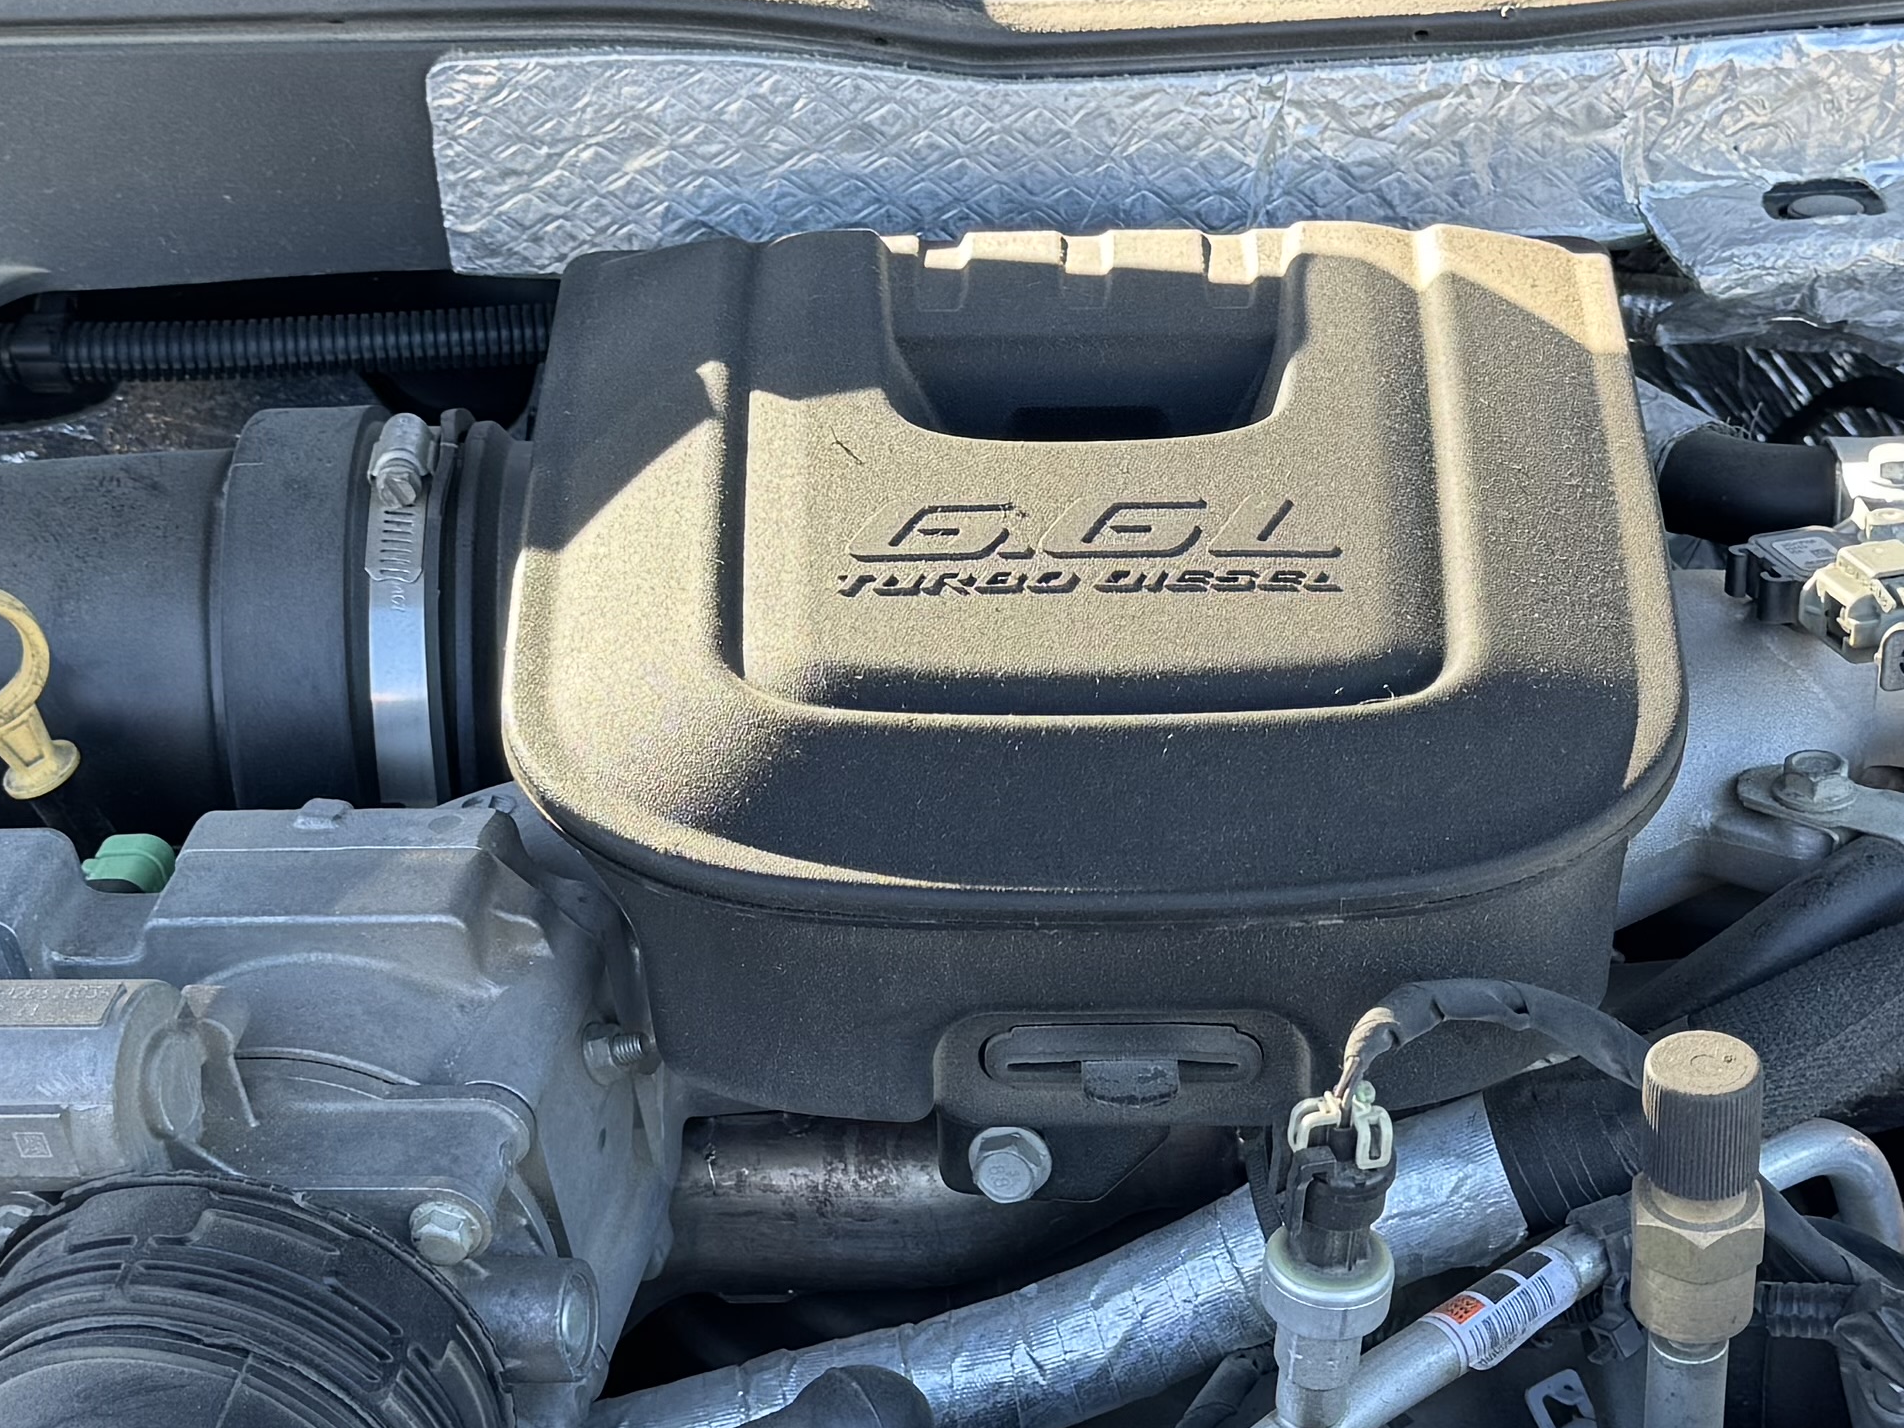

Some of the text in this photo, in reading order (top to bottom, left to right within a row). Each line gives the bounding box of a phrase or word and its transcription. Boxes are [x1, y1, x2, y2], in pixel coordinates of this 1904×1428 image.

[846, 497, 1343, 563] 6.6L
[837, 570, 1344, 597] TURBO DIESEL
